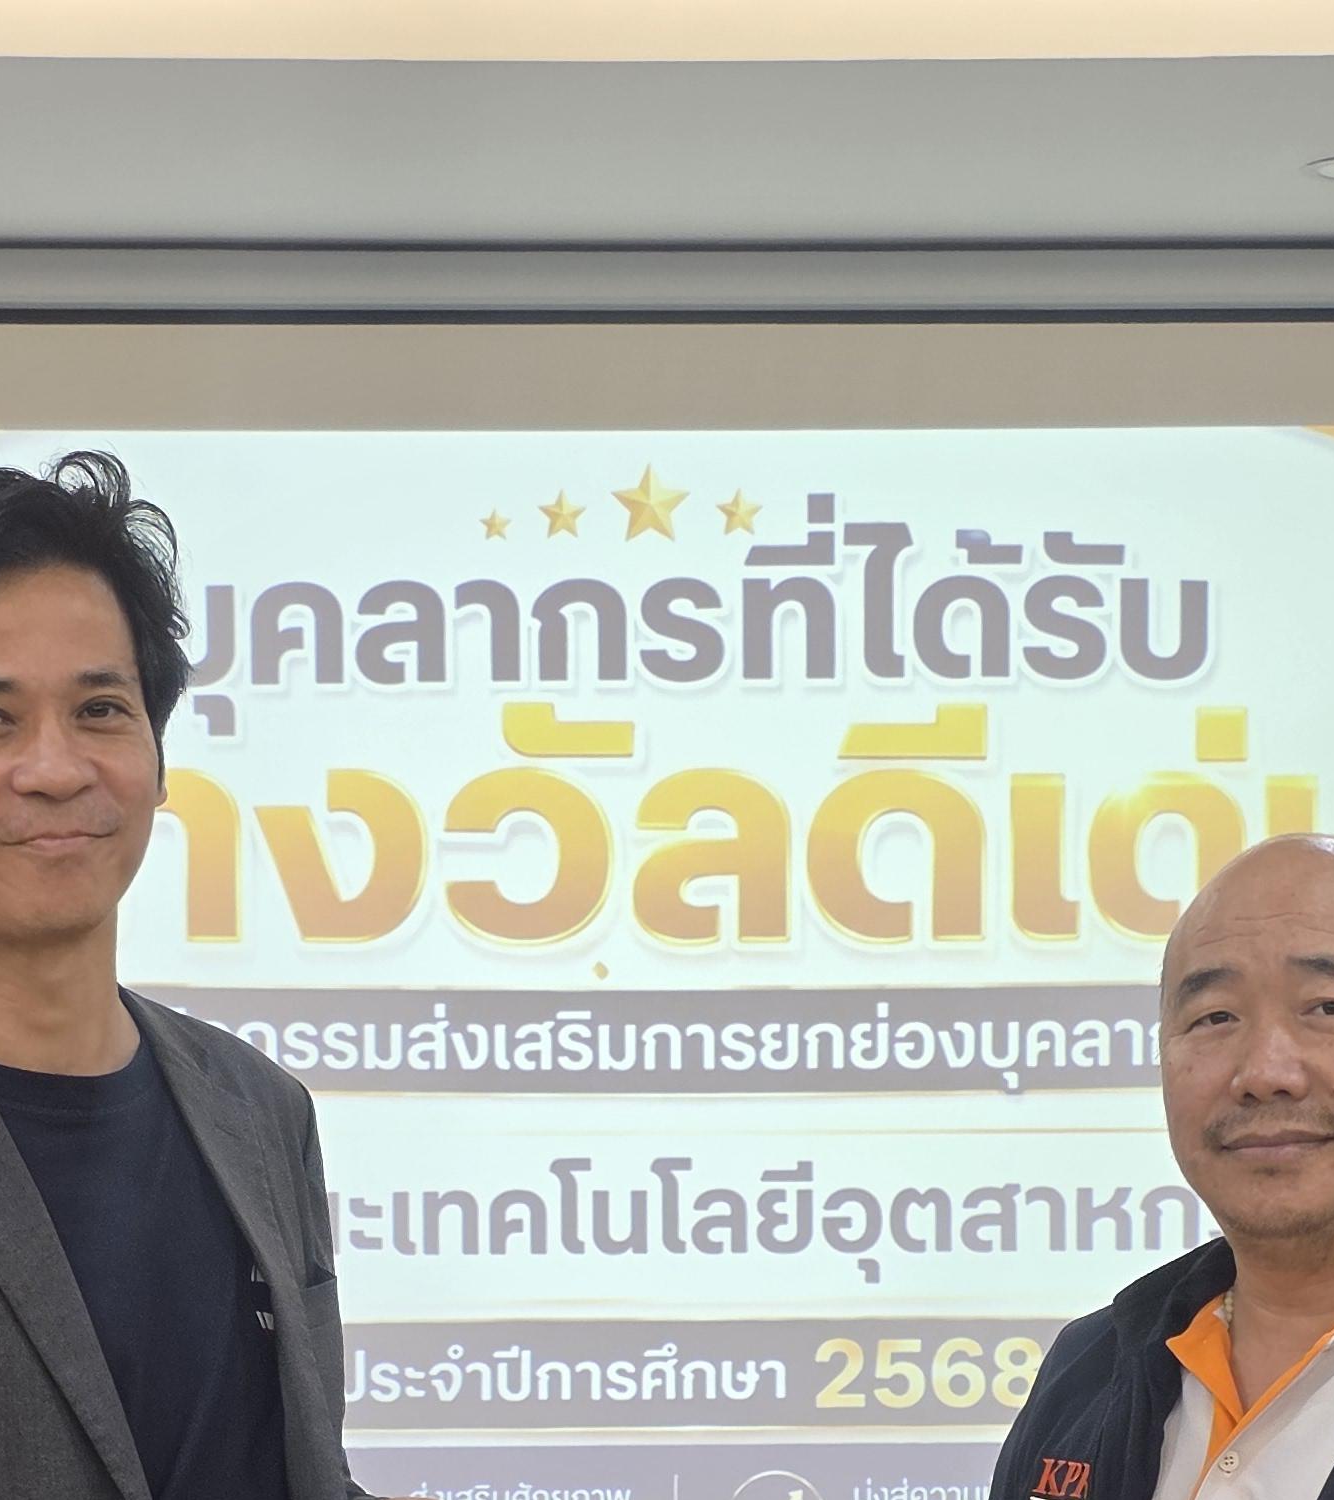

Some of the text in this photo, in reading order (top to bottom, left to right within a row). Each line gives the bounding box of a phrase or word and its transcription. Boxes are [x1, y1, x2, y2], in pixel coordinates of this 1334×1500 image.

[174, 1002, 1161, 1089] กรรมส่งเสริมการยกย่องบุคลา
[327, 1157, 1224, 1284] ะเทคโนโลยีอุตสาหก
[814, 1336, 1044, 1410] 2568
